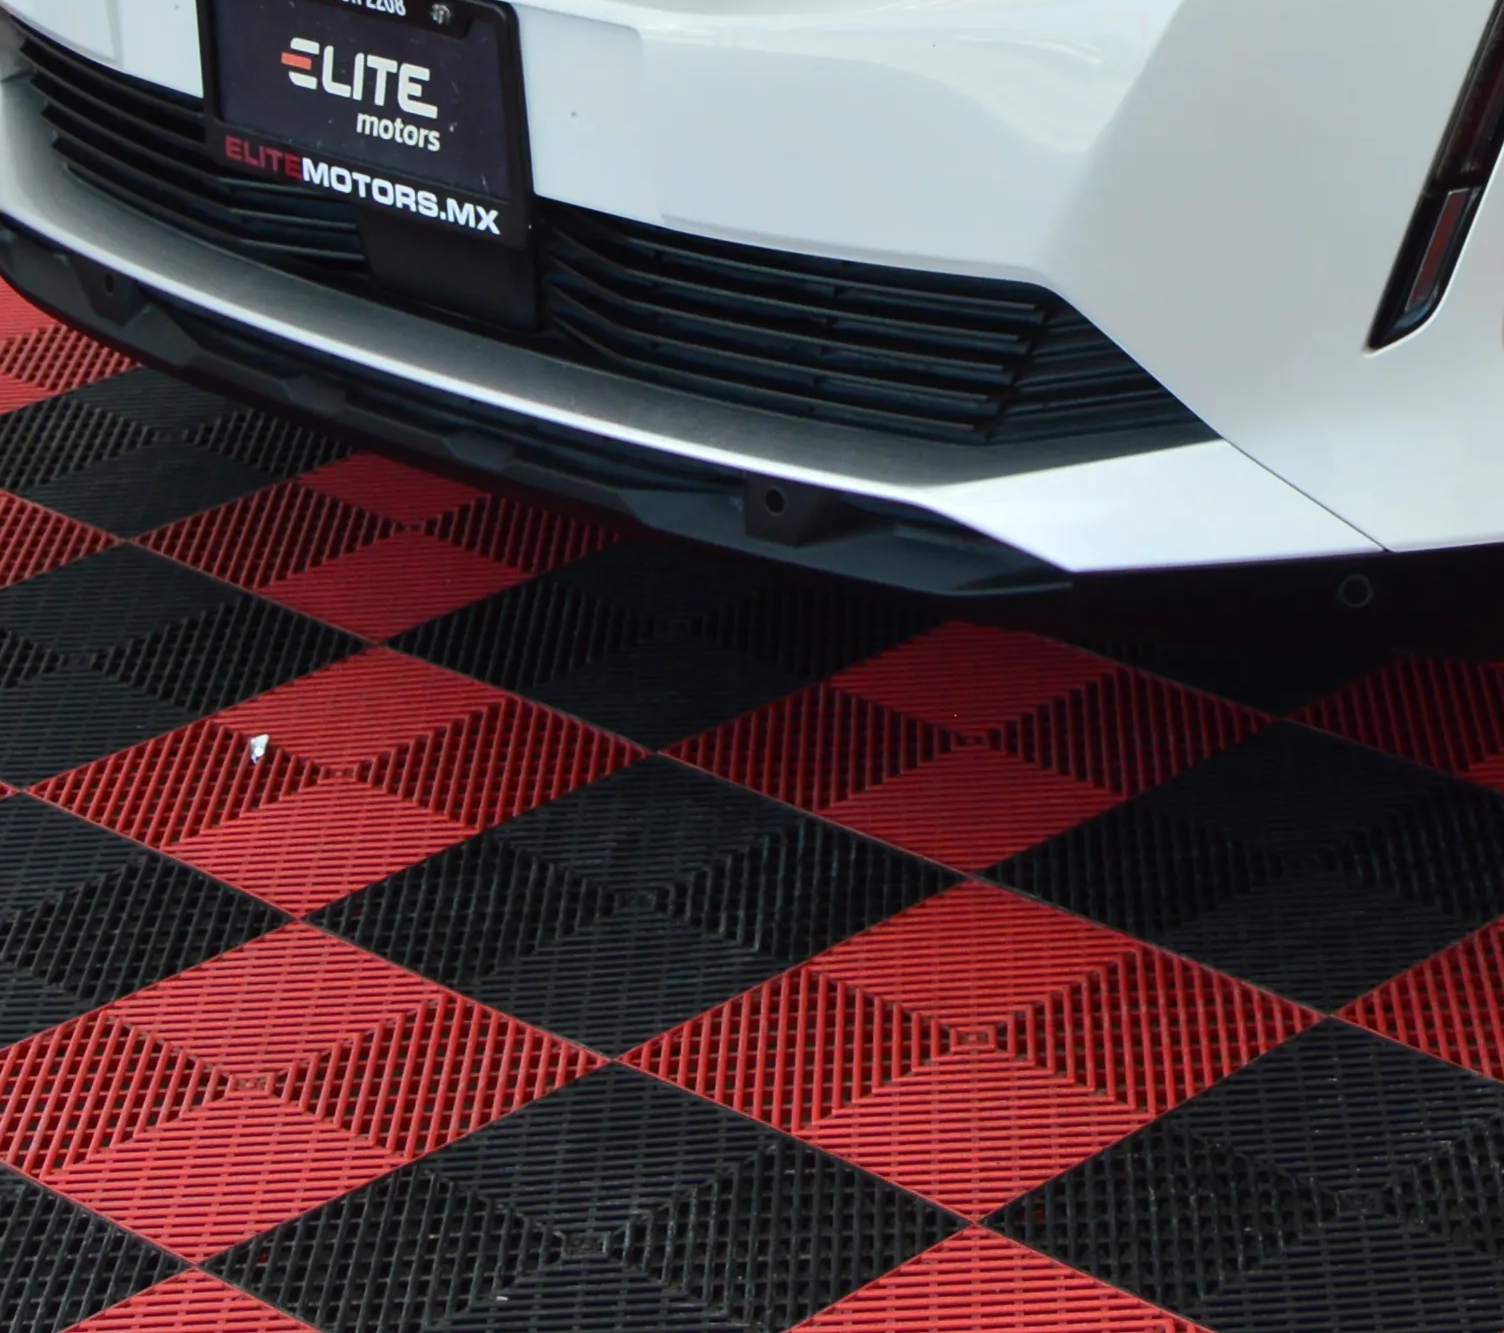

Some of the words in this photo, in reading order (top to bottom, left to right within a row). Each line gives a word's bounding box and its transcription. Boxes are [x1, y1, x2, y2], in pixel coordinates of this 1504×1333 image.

[281, 36, 439, 120] ELITE
[355, 112, 441, 152] motors
[224, 135, 501, 235] ELITEMOTORS.MX
